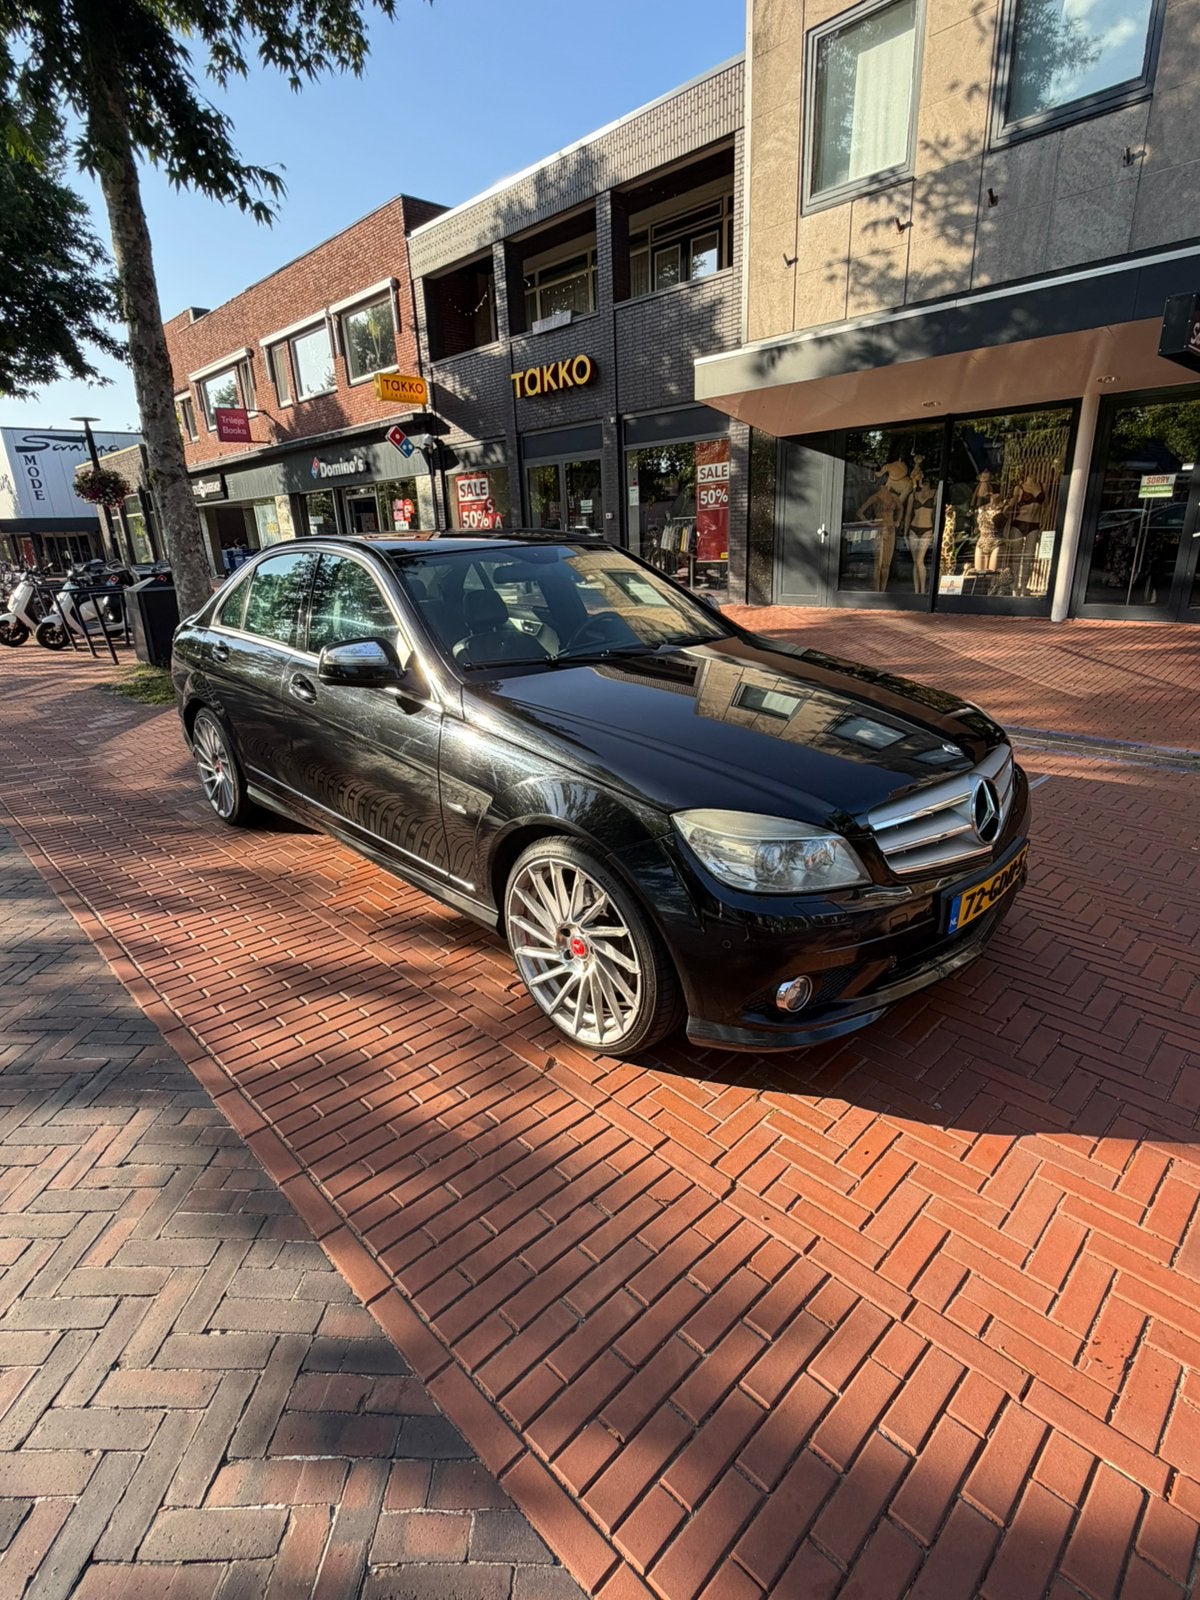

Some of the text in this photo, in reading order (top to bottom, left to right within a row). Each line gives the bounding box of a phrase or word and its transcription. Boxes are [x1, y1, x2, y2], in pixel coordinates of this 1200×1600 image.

[222, 425, 247, 435] Books
[320, 455, 364, 478] Domino's
[700, 464, 728, 480] SALE
[23, 454, 46, 501] MODE
[1146, 475, 1170, 485] SORRY
[460, 481, 487, 498] SALE
[700, 488, 729, 505] 50%
[462, 510, 489, 528] 50%
